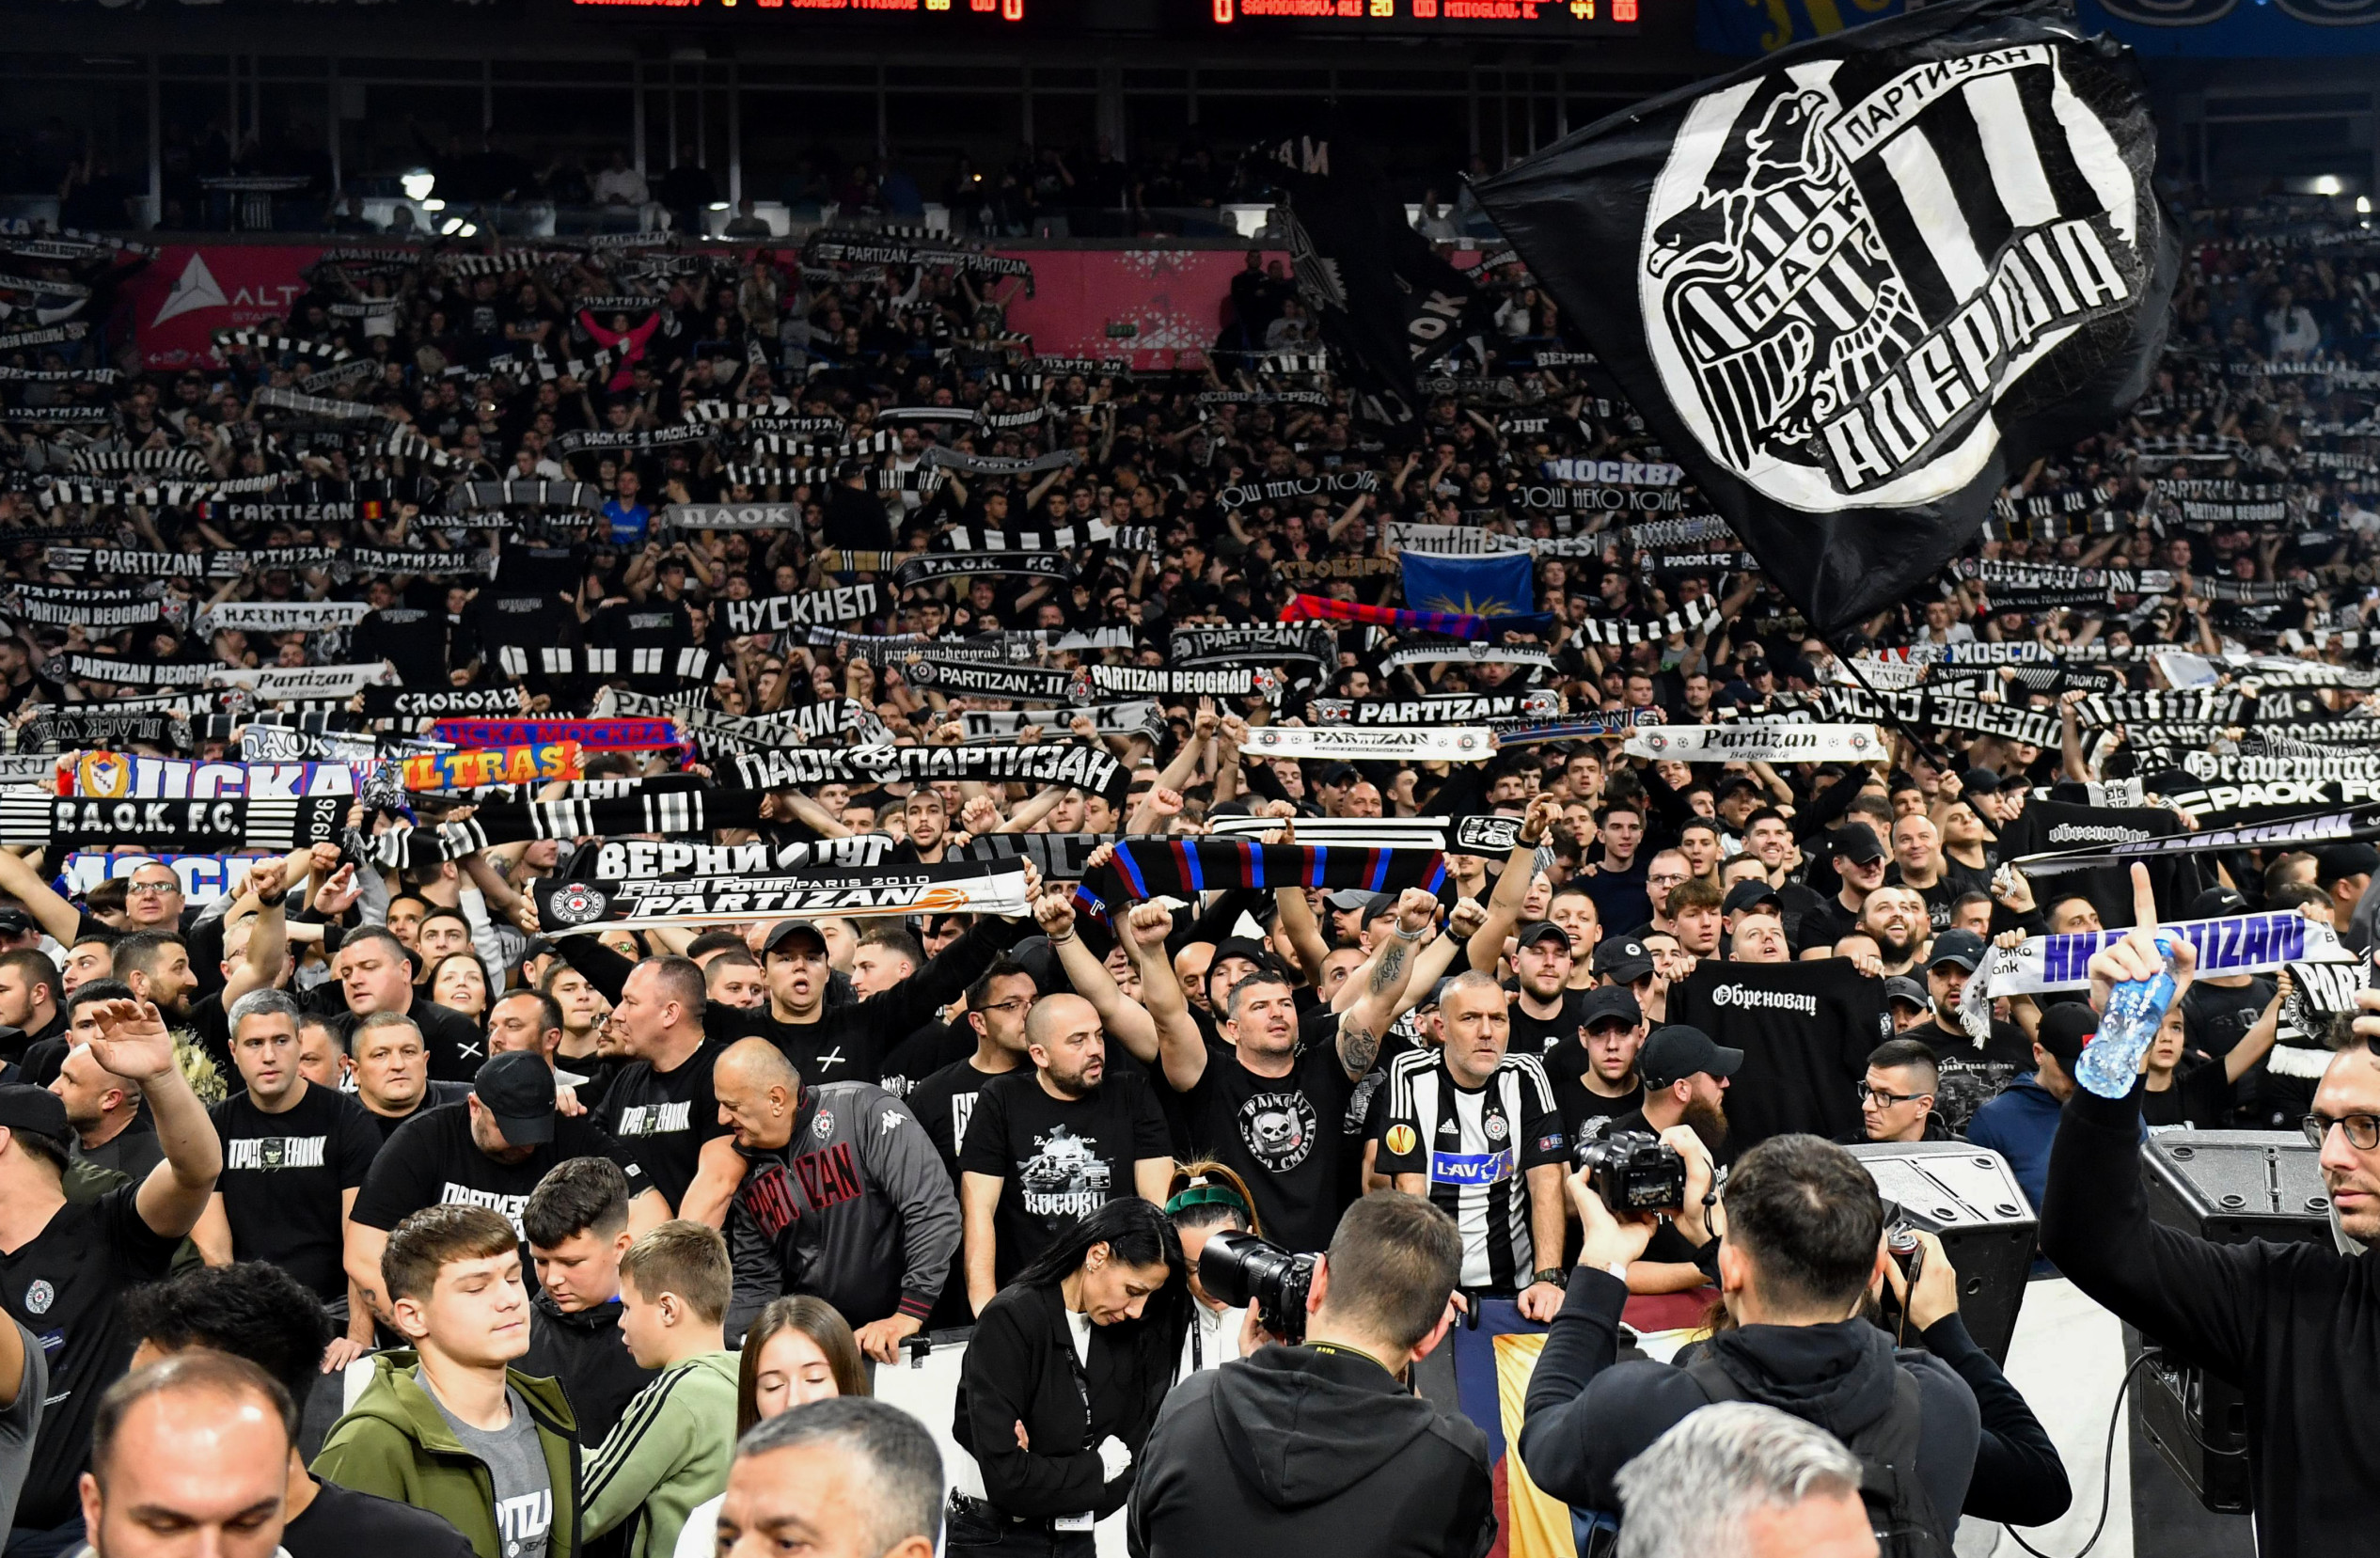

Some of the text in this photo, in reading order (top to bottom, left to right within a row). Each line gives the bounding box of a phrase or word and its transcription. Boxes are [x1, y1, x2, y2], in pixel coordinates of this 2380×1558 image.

[1370, 1, 1393, 16] 20
[1571, 1, 1593, 19] 44
[1845, 49, 2029, 146] ПАРТИЗАН
[847, 246, 908, 263] PARTIZAN
[967, 255, 1027, 275] PARTIZAN
[1744, 187, 1861, 322] ПАОК
[1041, 358, 1125, 371] ПАРТИАН
[228, 502, 355, 521] PARTIZAN
[682, 509, 792, 527] ПАОК
[2183, 500, 2234, 521] PARTIZAN
[95, 549, 203, 577] PARTIZAN
[355, 547, 465, 567] ПАРТИЗАН
[923, 554, 1056, 575] P.A.O.K. F.C.
[1663, 553, 1731, 567] PAOK FC
[13, 583, 132, 602] ПАРТИЗАН
[24, 599, 160, 626] PARTIZAN BEOGRAD
[1204, 630, 1305, 653] PARTIZAN
[71, 655, 148, 685] PARTIZAN
[939, 668, 1029, 693] PARTIZAN
[1092, 665, 1252, 694] PARTIZAN BEOGRAD
[2063, 673, 2106, 688] PAOK FC
[254, 669, 355, 697] Partizan
[394, 690, 520, 716] СЛОБОДА
[1359, 698, 1515, 725] PARTIZAN
[241, 731, 333, 763] ПАОК
[443, 726, 667, 746] ЦСКА МОСКВА
[1310, 730, 1429, 746] PARTIZAN
[1700, 727, 1820, 750] Partizan
[132, 760, 354, 798] ЦСКА
[733, 747, 1117, 794] ПАОК ПАРТИЗАН
[2207, 779, 2329, 811] PAOK
[56, 801, 241, 836] P.A.O.K. F.C.
[310, 798, 337, 842] 1926
[595, 833, 892, 880] ВЕРНИ ЈУГ
[629, 875, 930, 898] Final Four PARIS 2010
[644, 885, 920, 916] PARTIZAN
[1993, 961, 2020, 976] ank
[1711, 981, 1818, 1017] Обреновац
[1436, 1161, 1478, 1178] LAV
